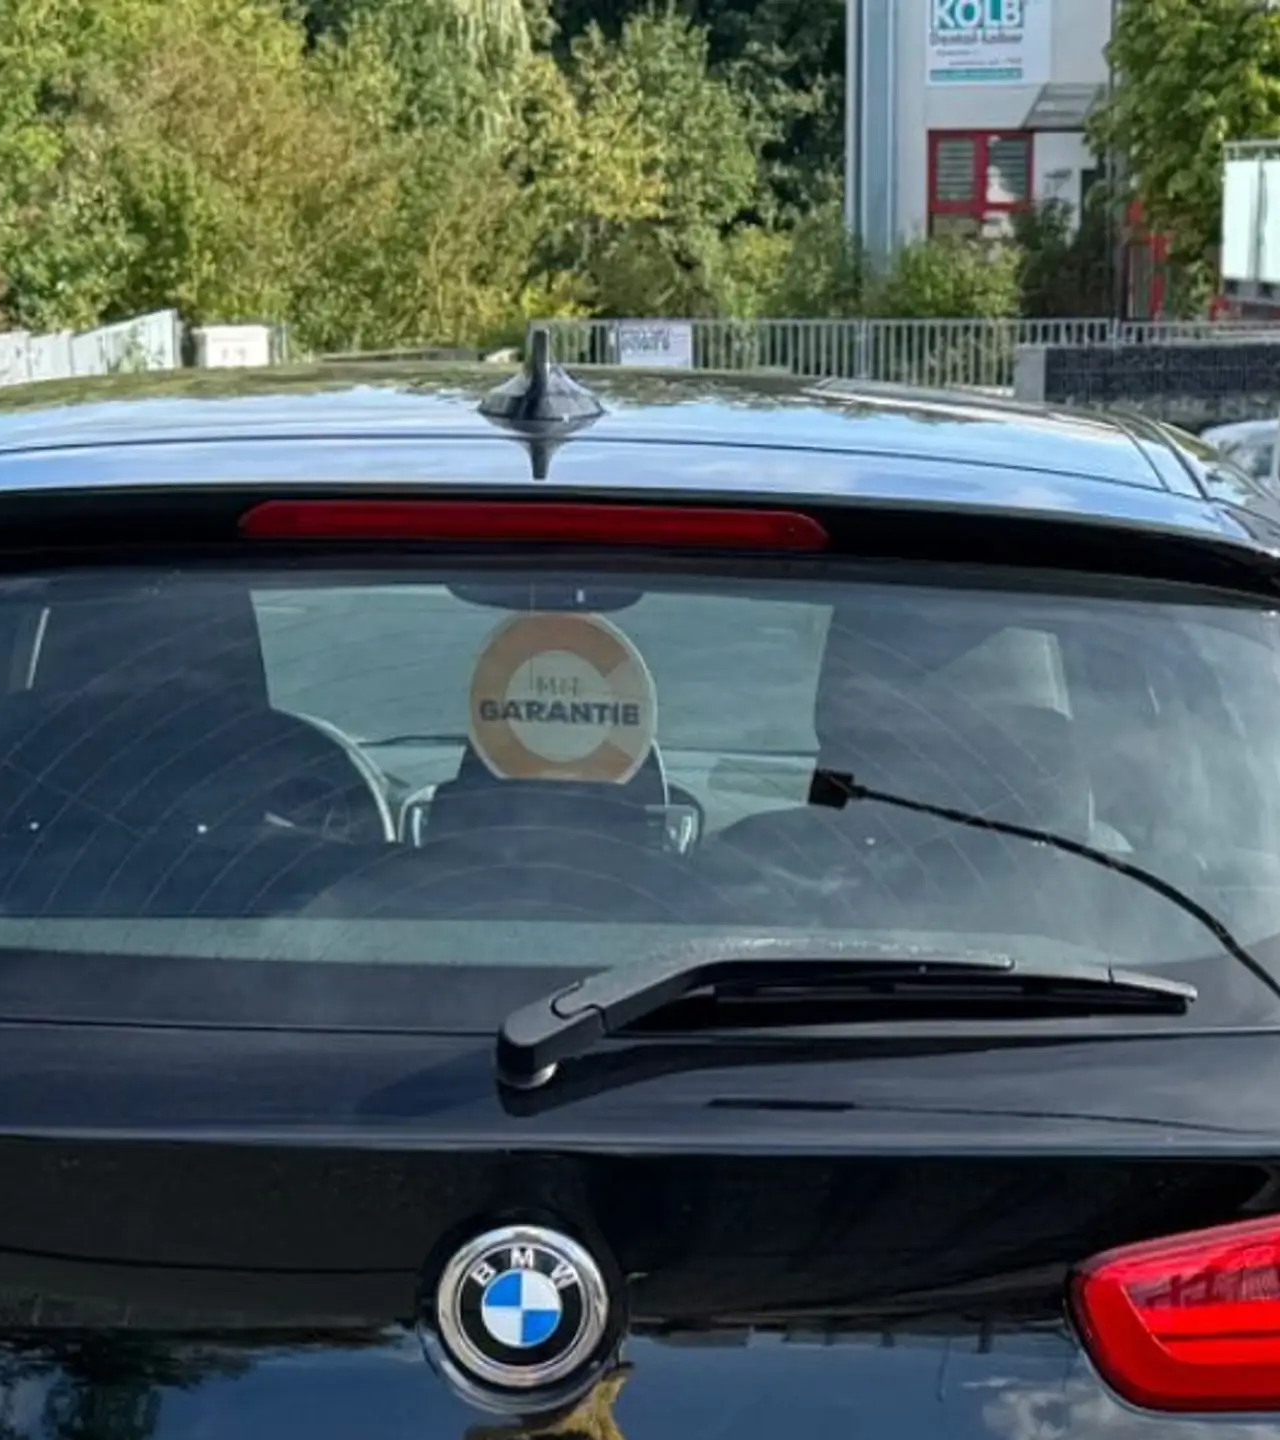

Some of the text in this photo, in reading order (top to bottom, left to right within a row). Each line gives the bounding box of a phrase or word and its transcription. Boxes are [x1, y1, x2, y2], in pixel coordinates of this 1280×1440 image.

[931, 0, 1024, 28] KOLB
[479, 699, 641, 725] GARANTIE
[470, 1246, 579, 1291] BMW
